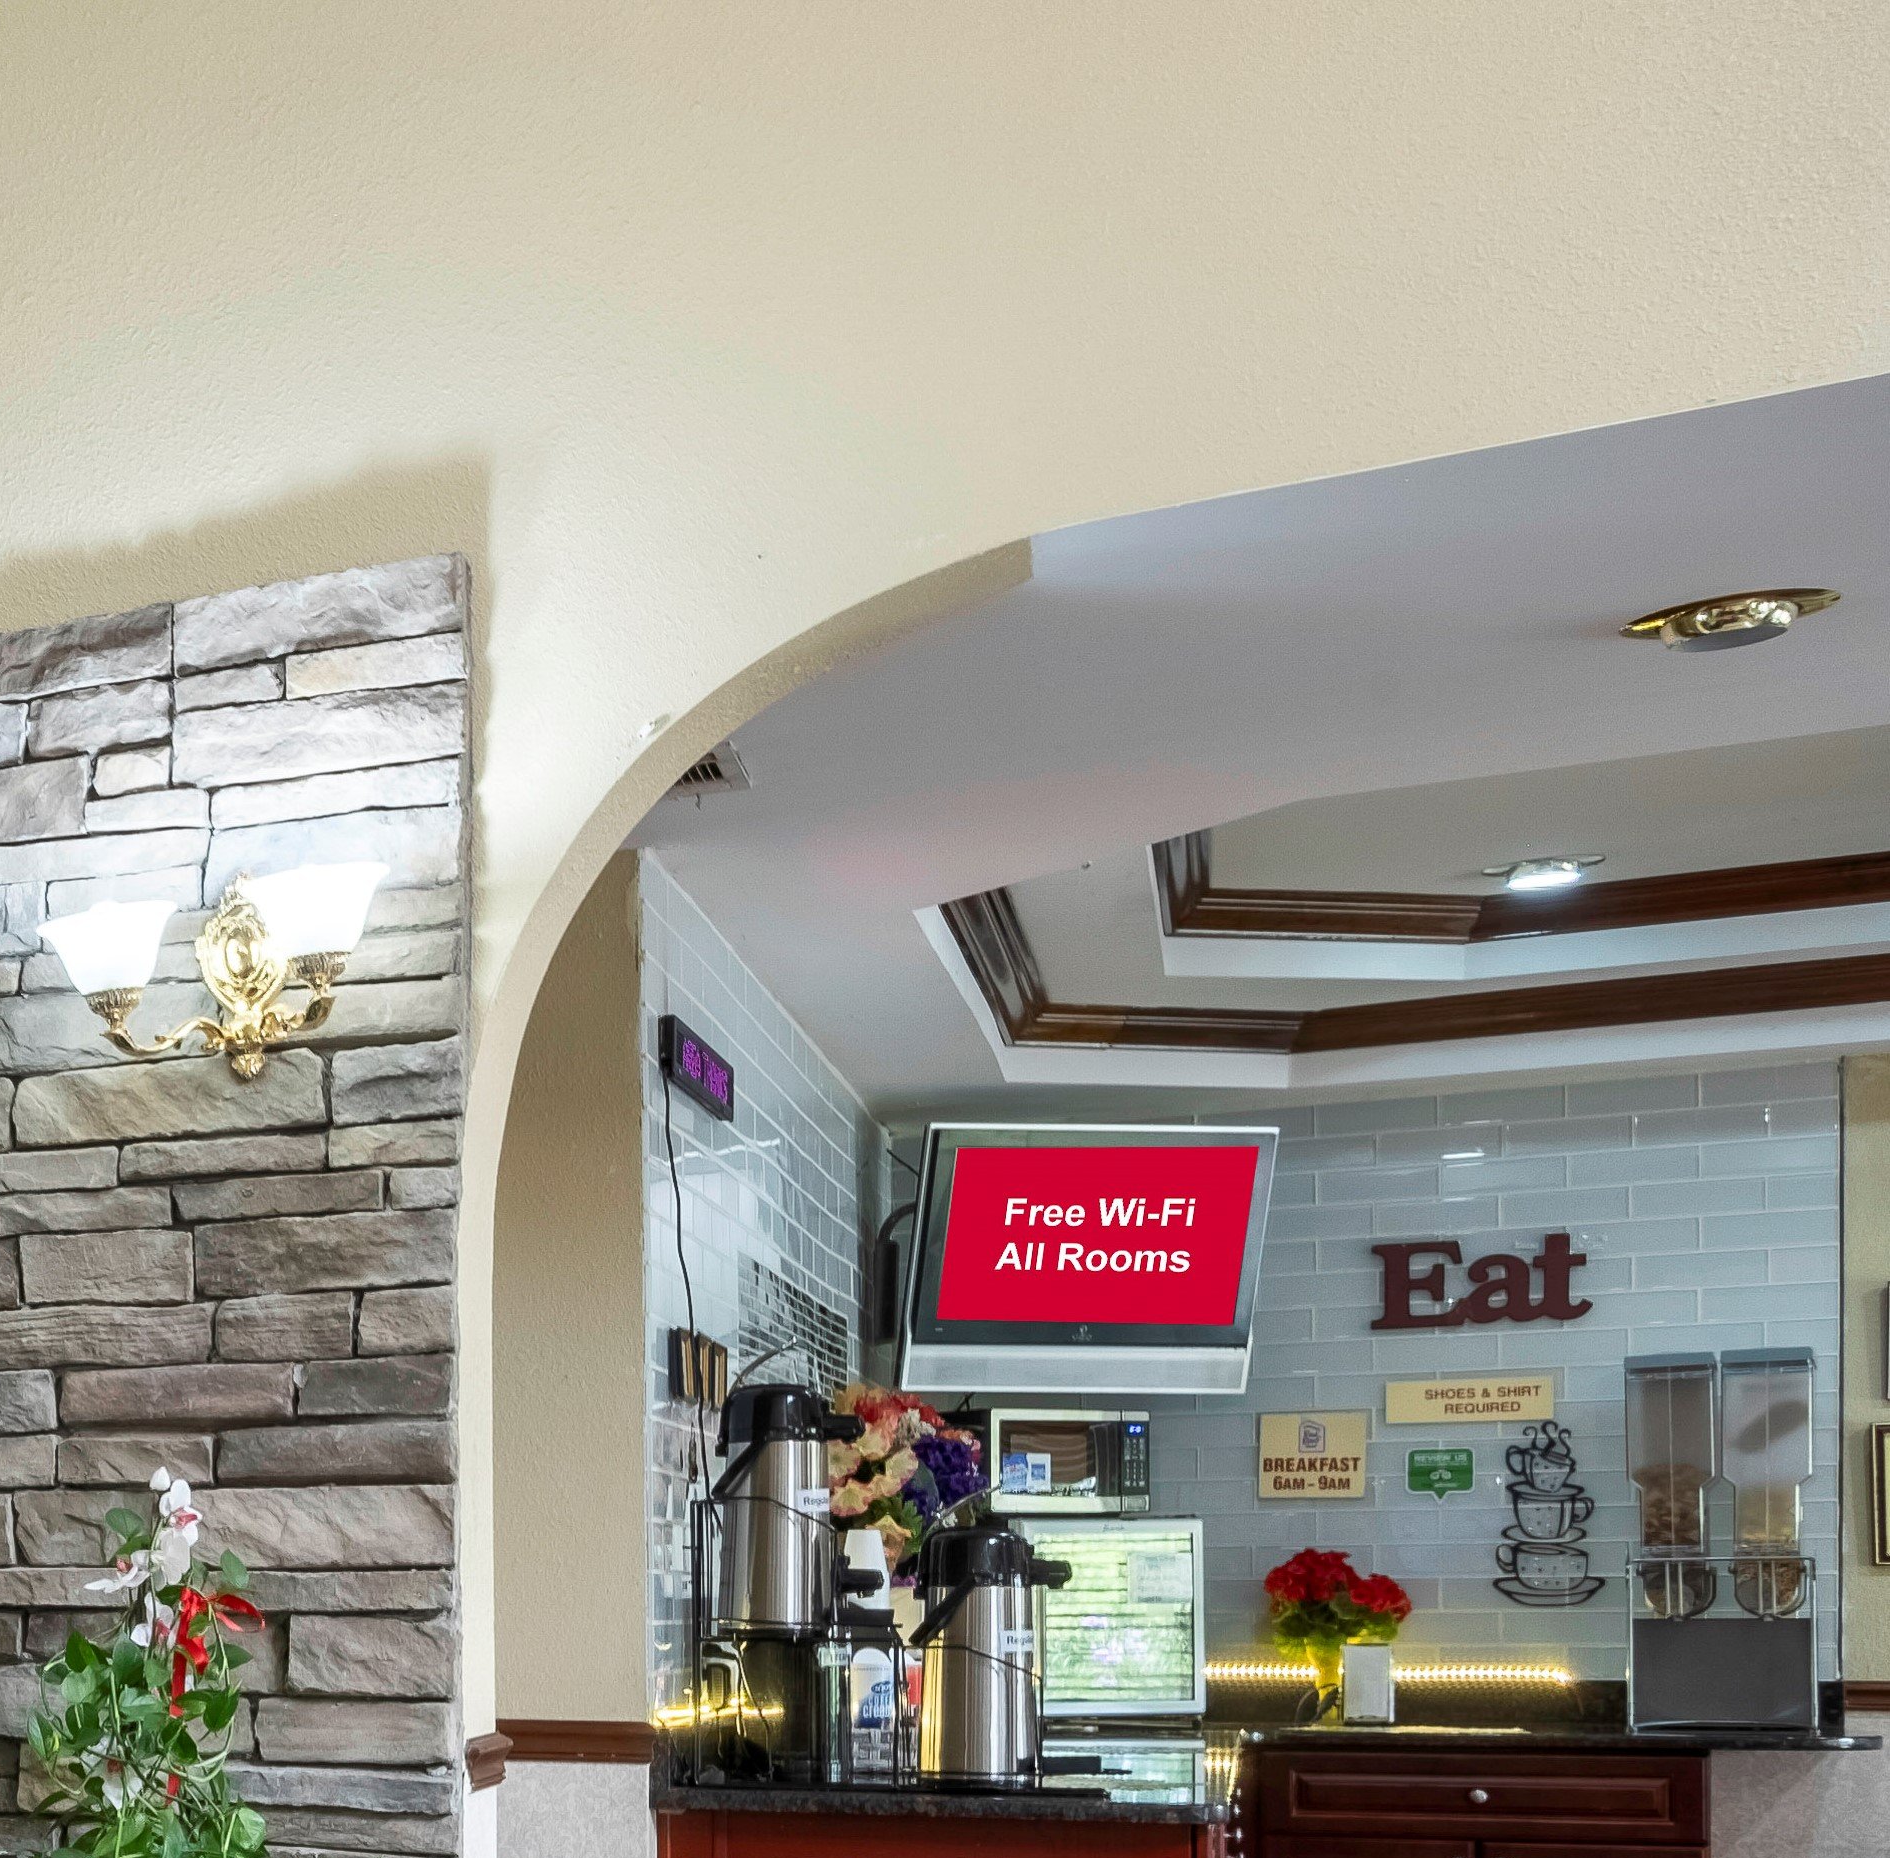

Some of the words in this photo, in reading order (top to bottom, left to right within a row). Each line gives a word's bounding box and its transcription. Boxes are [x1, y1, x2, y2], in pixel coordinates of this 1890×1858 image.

[1003, 1197, 1086, 1227] Free
[1098, 1197, 1196, 1227] Wi-Fi
[994, 1242, 1046, 1271] All
[1056, 1242, 1191, 1273] Rooms
[1370, 1232, 1594, 1330] Eat
[1424, 1387, 1476, 1400] SHOES
[1497, 1385, 1542, 1398] SHIRT
[1444, 1401, 1521, 1415] REQUIRED
[1262, 1457, 1361, 1472] BREAKFAST
[1272, 1475, 1305, 1490] 6AM
